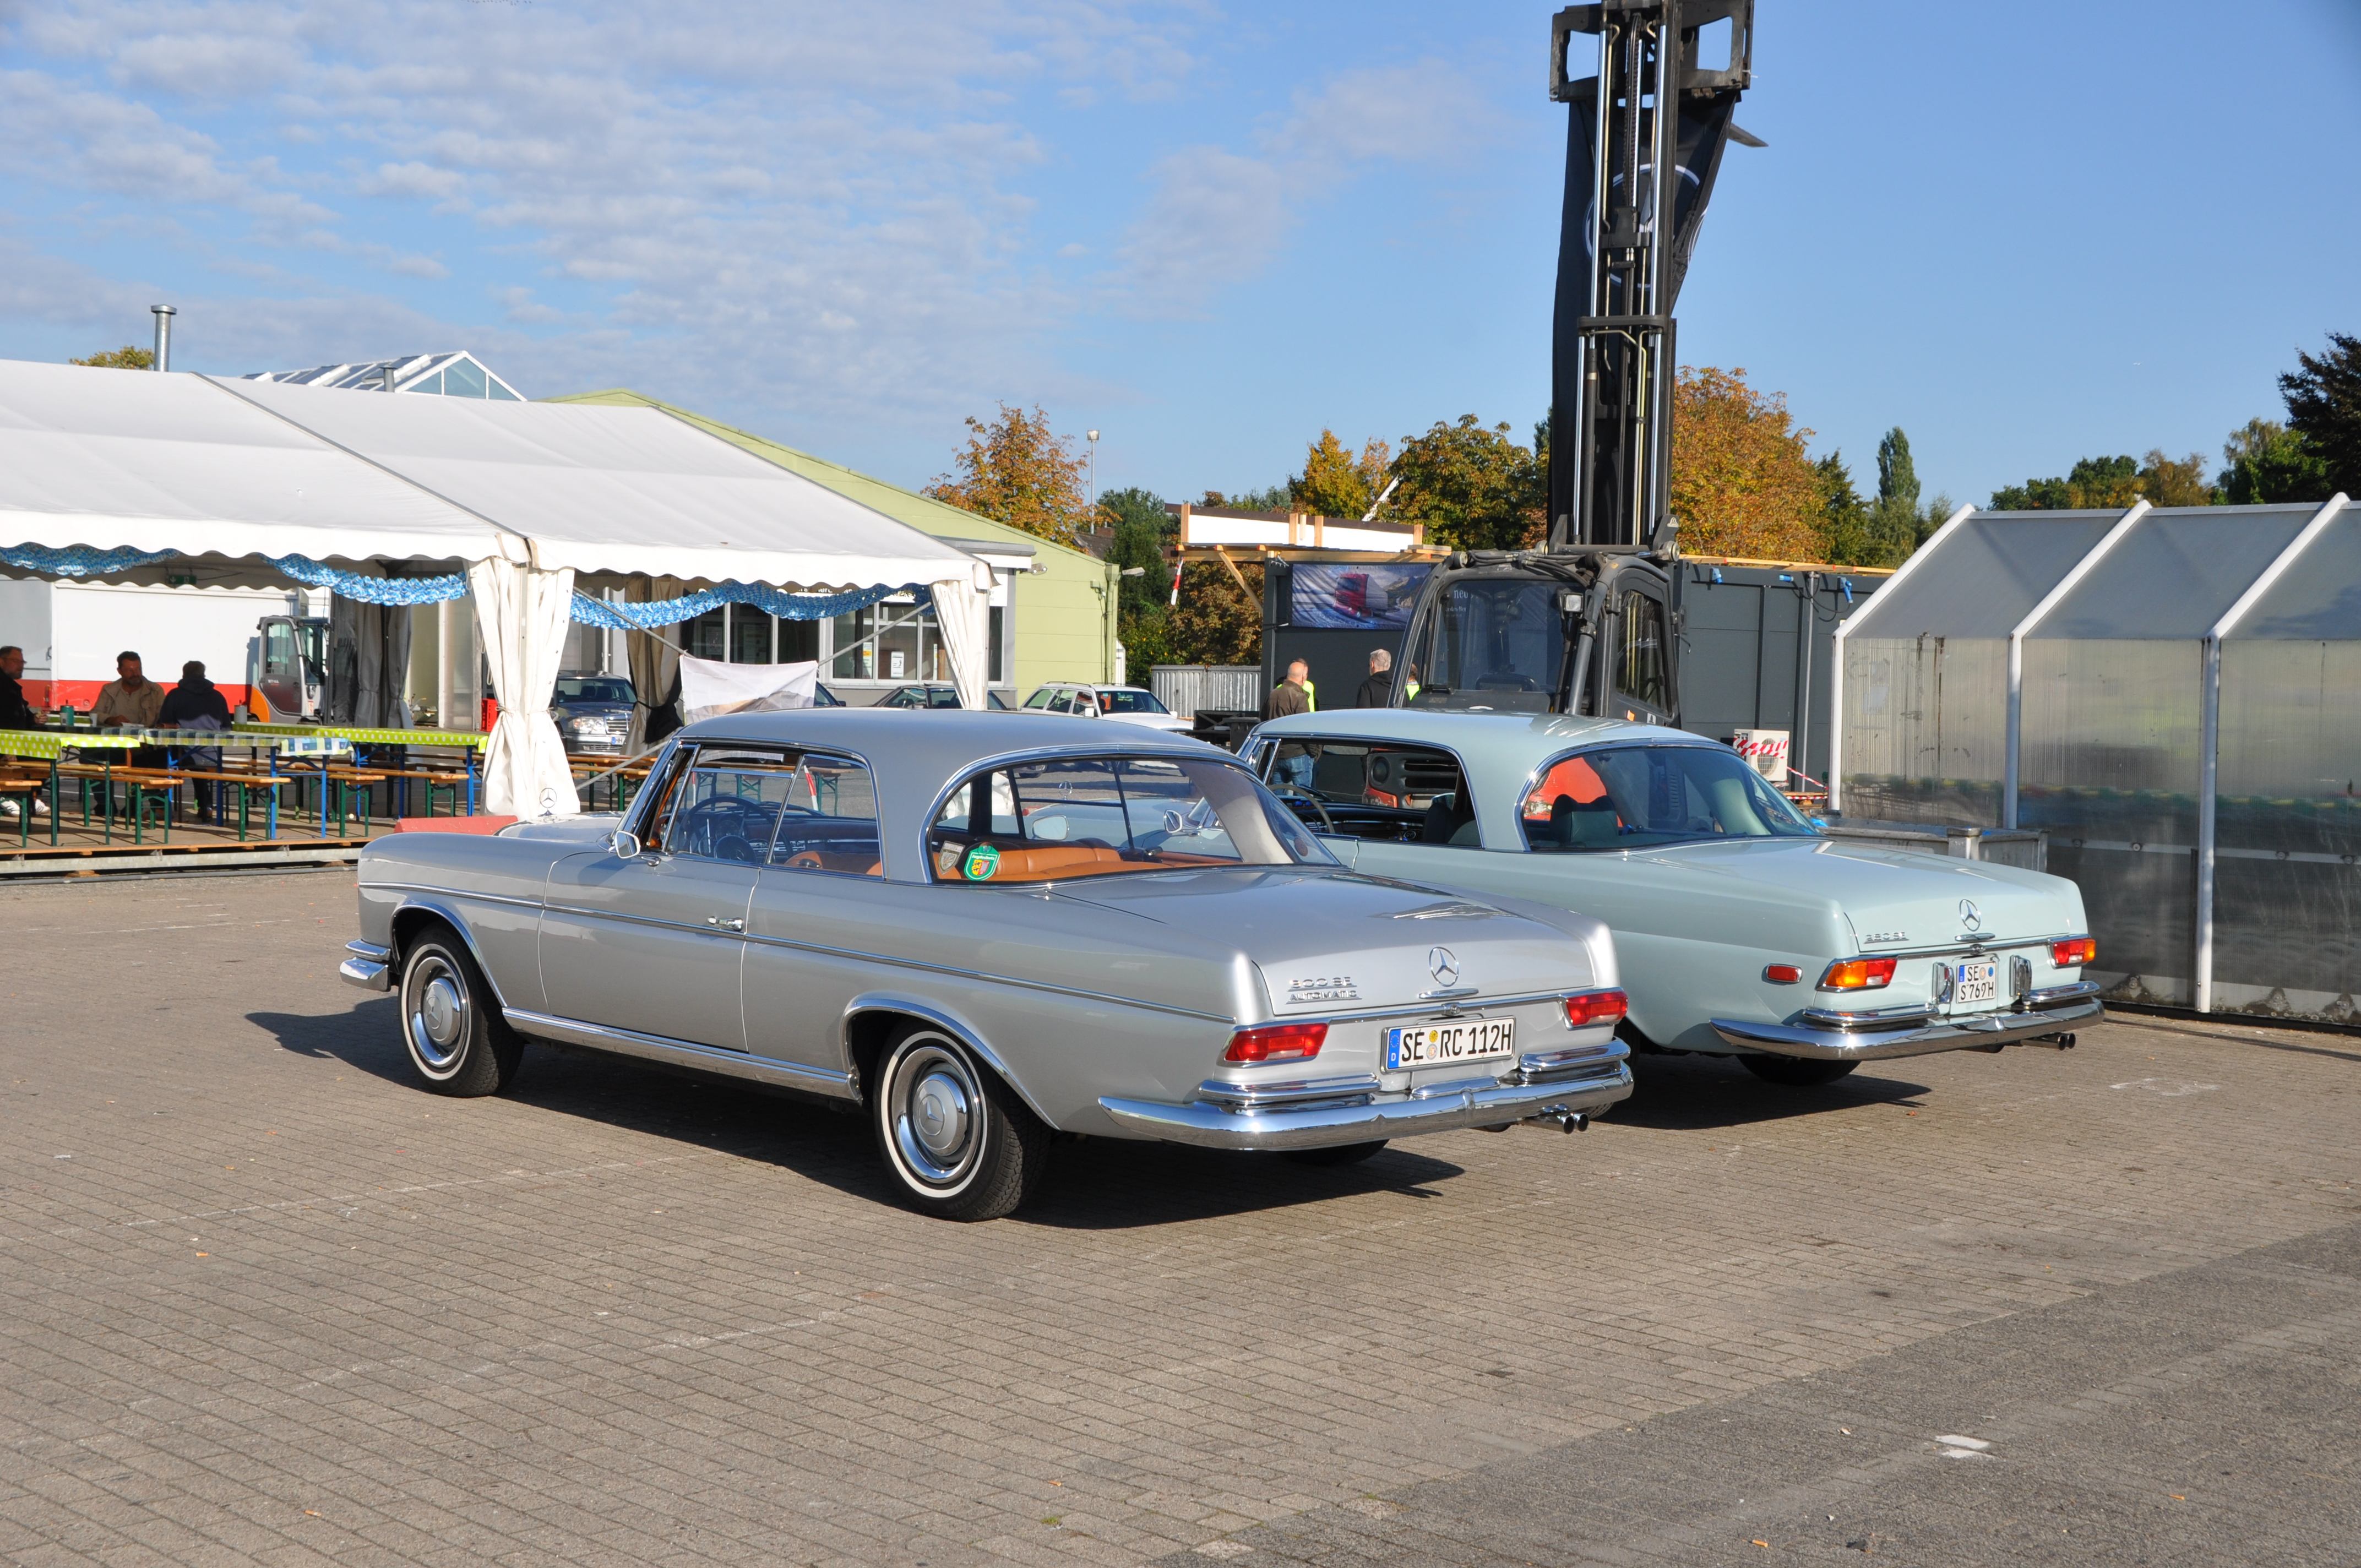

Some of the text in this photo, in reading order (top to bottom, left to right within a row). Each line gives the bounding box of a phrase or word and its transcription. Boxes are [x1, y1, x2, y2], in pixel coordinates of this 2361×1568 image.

[1866, 932, 1906, 941] 280 SE
[1967, 966, 1979, 982] SE
[1289, 977, 1352, 988] 300 SE
[1289, 990, 1357, 1001] AUTOMATIC
[1960, 982, 1994, 1000] S 769H
[1401, 1023, 1513, 1062] SE RC 112H
[1391, 1053, 1396, 1061] D
